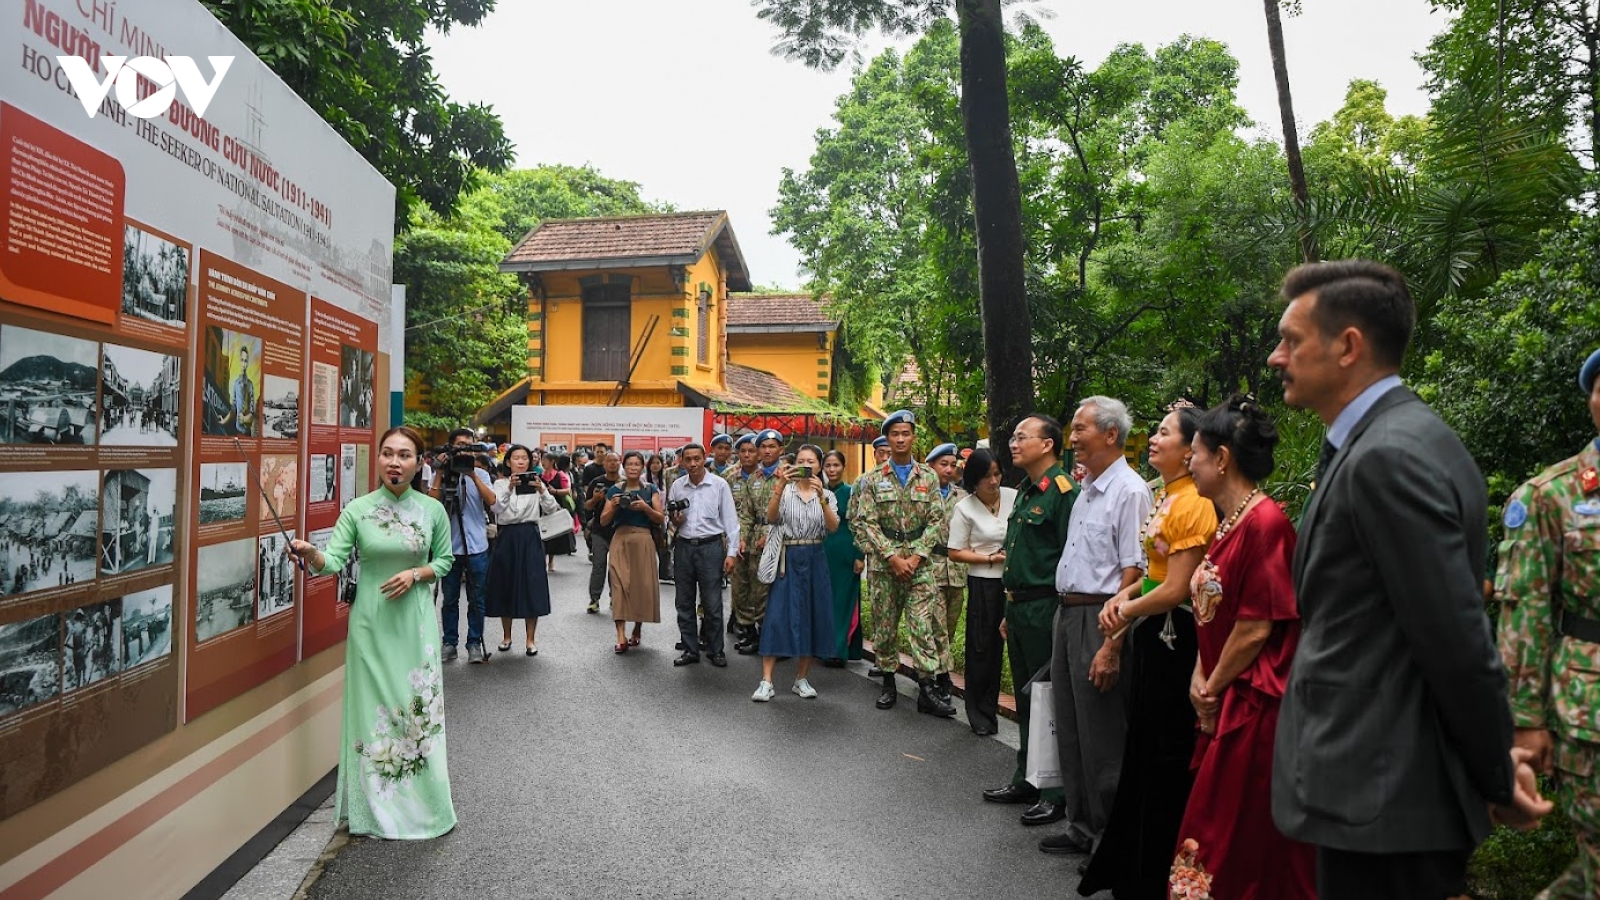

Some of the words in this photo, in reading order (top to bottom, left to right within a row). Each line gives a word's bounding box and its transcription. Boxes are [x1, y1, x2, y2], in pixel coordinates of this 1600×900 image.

[119, 16, 174, 66] MIN
[22, 44, 52, 82] HO
[135, 116, 160, 147] THE
[160, 131, 202, 172] SEEKER
[202, 157, 217, 180] OF
[217, 166, 261, 208] NATIONAL
[261, 195, 301, 232] SALVATION
[223, 135, 247, 170] CỨU
[249, 152, 280, 193] NƯỚC
[281, 177, 332, 230] (1911-1941)
